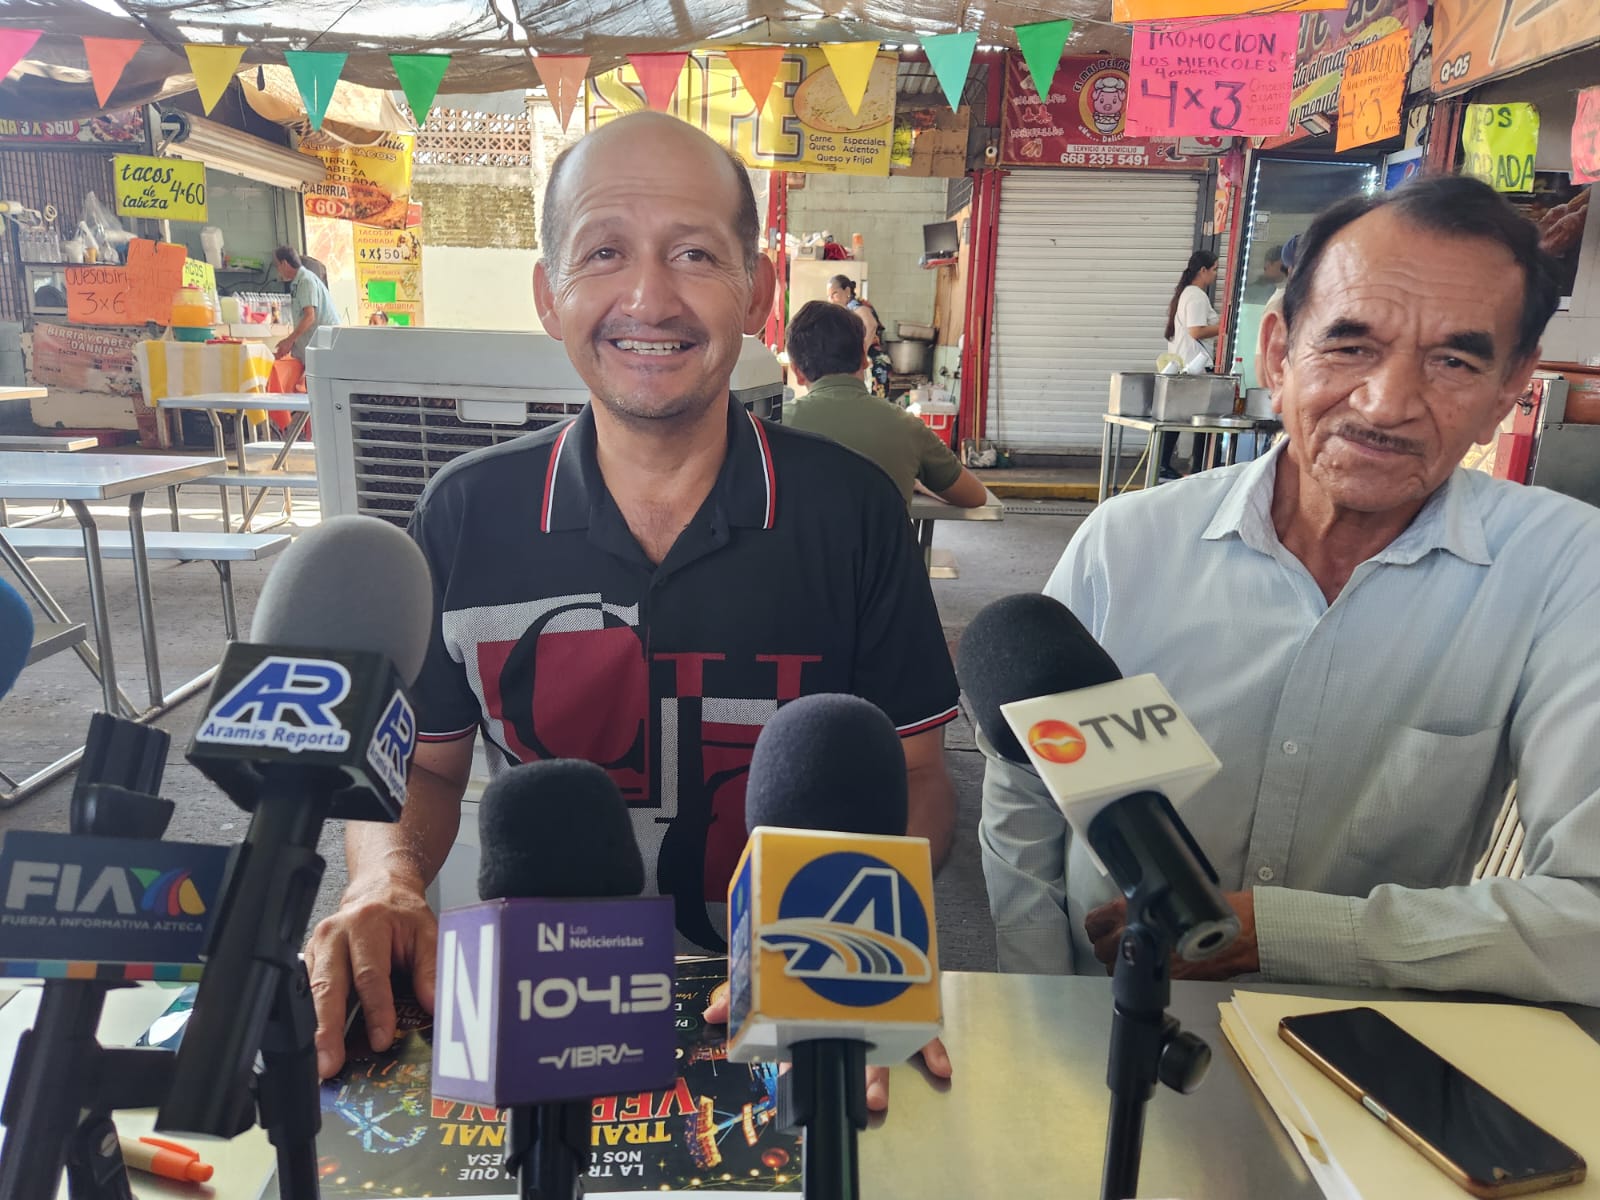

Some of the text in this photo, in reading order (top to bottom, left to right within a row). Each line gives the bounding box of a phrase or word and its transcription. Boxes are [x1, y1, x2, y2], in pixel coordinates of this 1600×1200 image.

[1141, 56, 1169, 67] LOS
[1440, 52, 1472, 83] Q-05
[1300, 84, 1340, 119] menud
[808, 143, 836, 152] Queso
[809, 134, 887, 147] Carne Especiales
[1073, 145, 1100, 153] SERVICIO
[1107, 146, 1138, 154] DOMICILIO
[322, 155, 358, 167] IRRIA
[816, 153, 874, 165] Queso y Frijol
[1060, 152, 1150, 166] 668 235 5491
[121, 163, 174, 184] tacos
[326, 165, 367, 178] ABEZA
[143, 184, 156, 197] de
[360, 248, 366, 259] 4
[47, 327, 85, 340] BIRRIA
[95, 335, 131, 349] CABEZ
[210, 657, 350, 729] AR
[203, 723, 346, 747] Aramis Reporta
[1078, 703, 1178, 753] TVP
[5, 860, 137, 915] FIA
[1, 914, 204, 933] FUERZA INFORMATIVA AZTECA
[569, 924, 589, 936] Los
[569, 935, 645, 950] Noticieristas
[517, 973, 673, 1021] 104.3
[538, 1042, 644, 1070] VIBRA
[438, 1123, 508, 1147] NAL
[466, 1153, 503, 1167] ESA
[602, 1150, 642, 1163] NOS
[457, 1167, 500, 1180] QUE
[619, 1164, 645, 1176] LA
